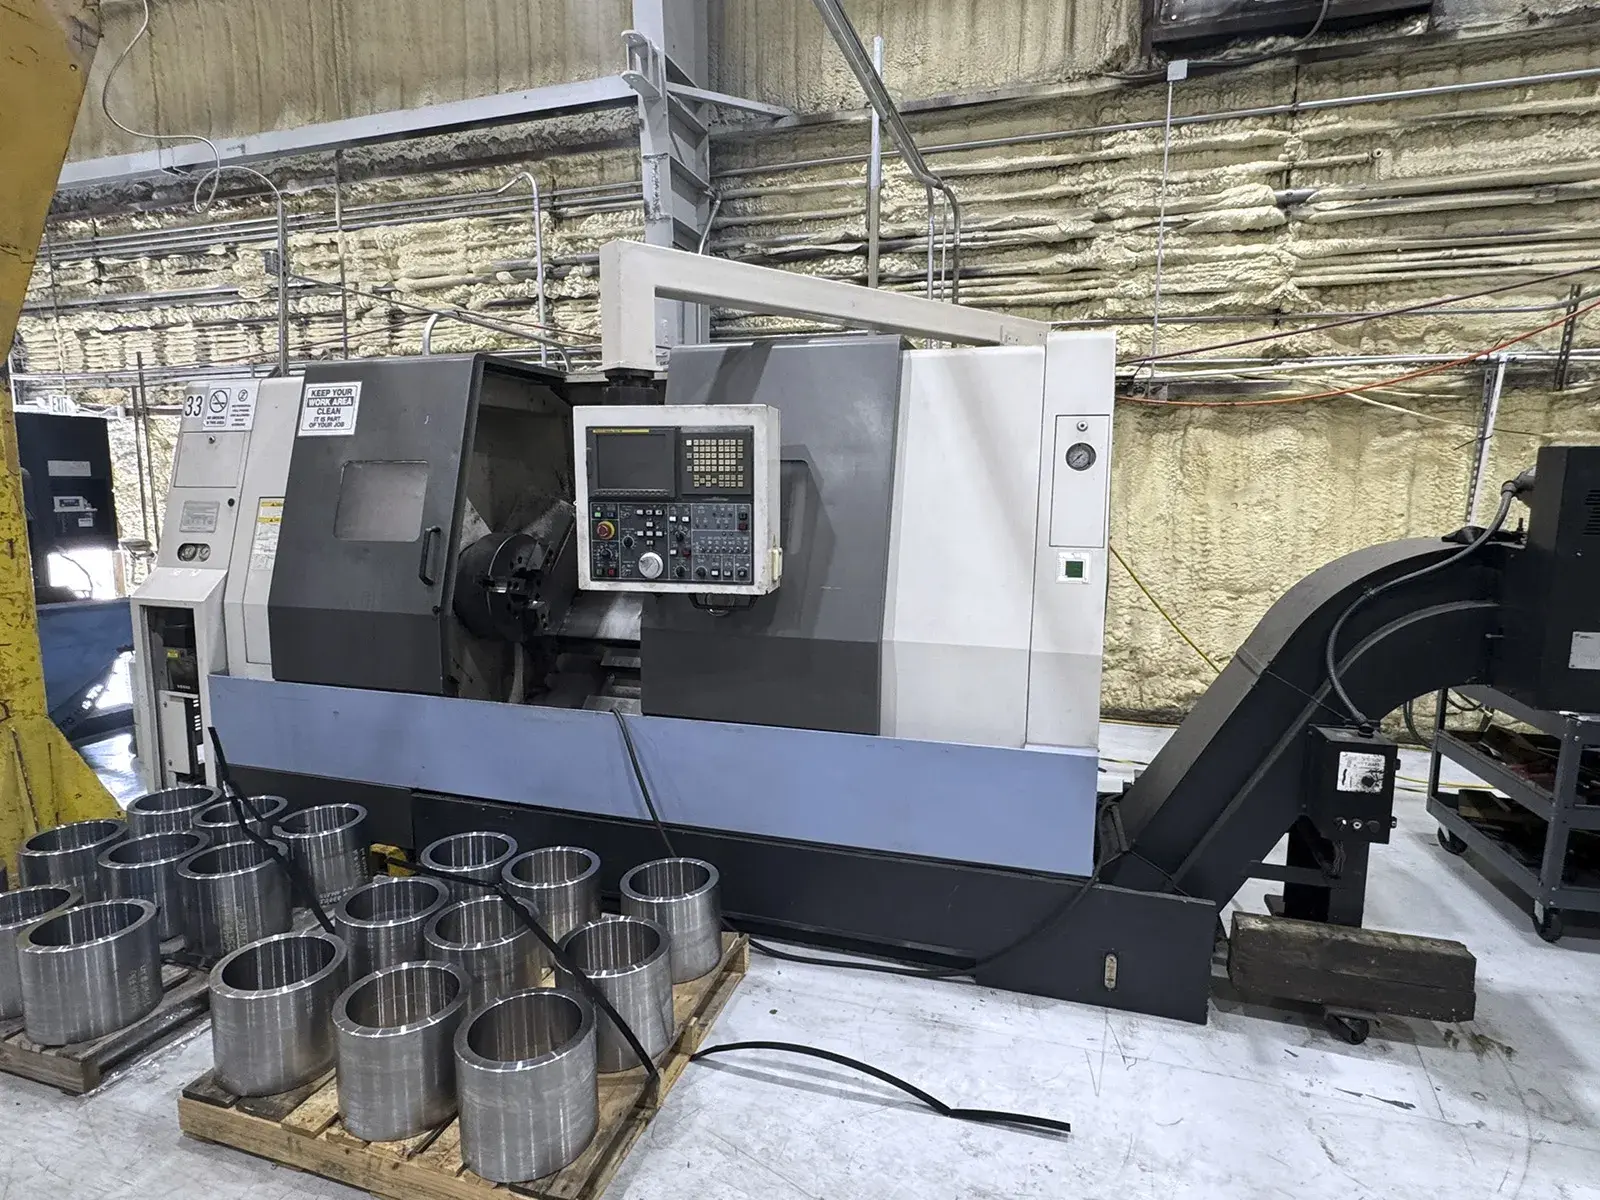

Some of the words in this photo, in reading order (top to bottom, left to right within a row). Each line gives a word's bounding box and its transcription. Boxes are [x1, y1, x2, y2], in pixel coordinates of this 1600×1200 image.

[185, 396, 203, 416] 33
[308, 398, 331, 406] WORK
[331, 397, 352, 406] AREA
